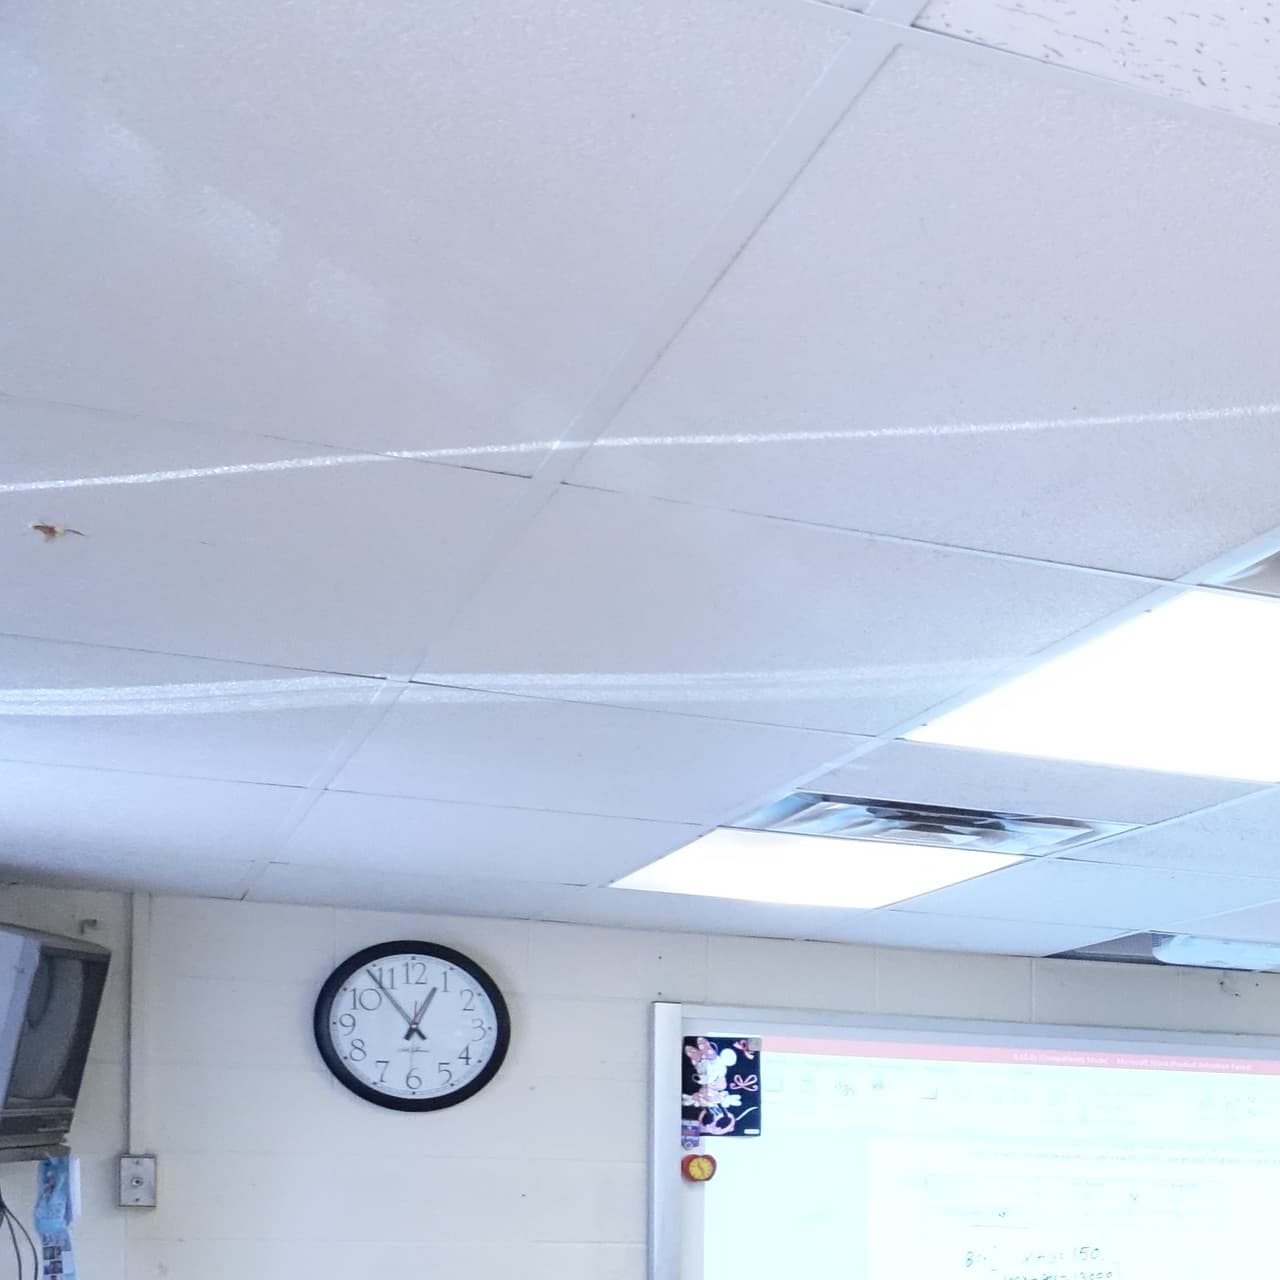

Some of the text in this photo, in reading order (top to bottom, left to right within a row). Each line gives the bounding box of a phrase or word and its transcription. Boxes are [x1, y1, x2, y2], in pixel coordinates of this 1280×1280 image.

[378, 967, 397, 990] 11
[403, 962, 427, 985] 12
[442, 971, 449, 993] 1
[351, 988, 382, 1011] 10
[460, 989, 475, 1011] 2
[339, 1013, 356, 1036] 9
[471, 1018, 486, 1041] 3
[350, 1038, 367, 1062] 8
[458, 1045, 472, 1065] 4
[376, 1060, 390, 1083] 7
[406, 1067, 423, 1090] 6
[437, 1062, 453, 1085] 5
